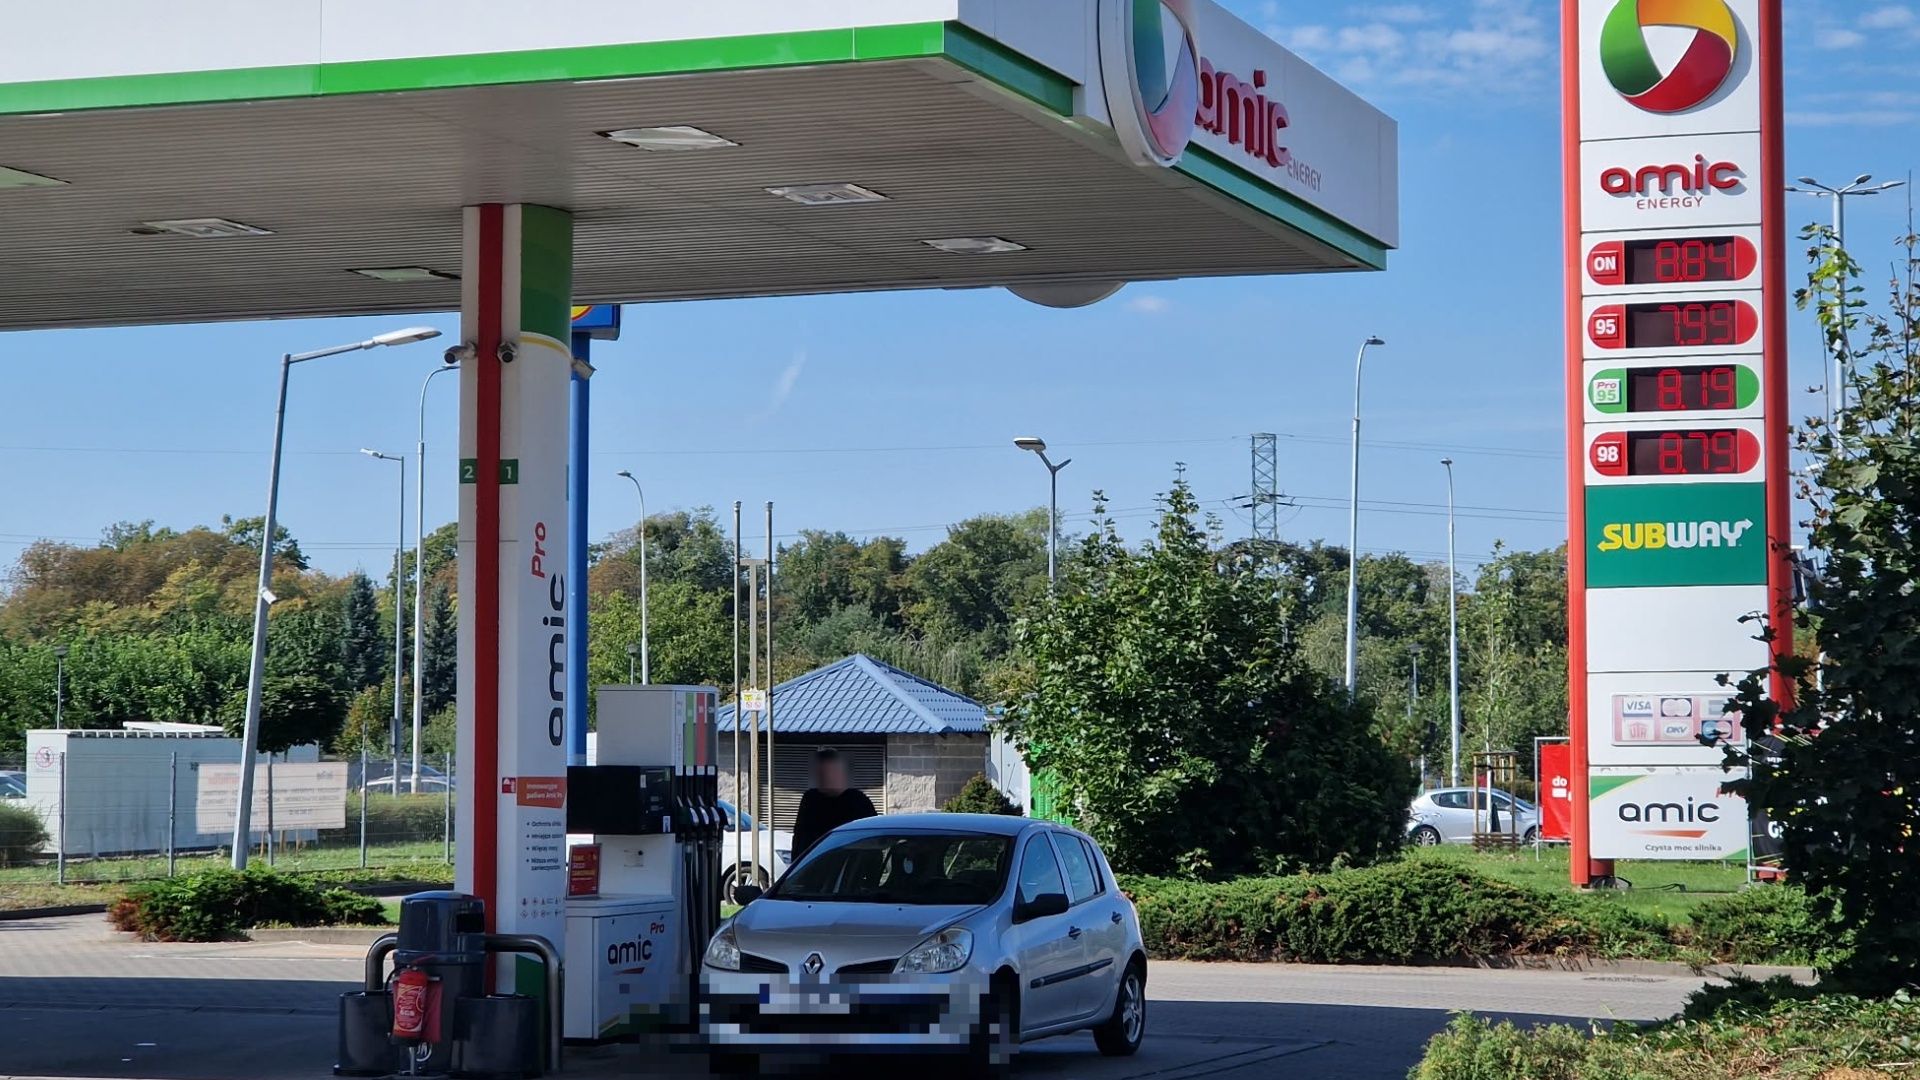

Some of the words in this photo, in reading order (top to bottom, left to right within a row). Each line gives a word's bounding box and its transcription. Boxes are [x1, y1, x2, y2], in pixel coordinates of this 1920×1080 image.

[1195, 56, 1291, 168] amic
[1287, 158, 1323, 192] ENERGY
[1600, 154, 1740, 195] amic
[1636, 196, 1704, 210] ENERGY
[1594, 256, 1617, 271] ON
[1655, 240, 1733, 282] 8.84
[1595, 318, 1617, 335] 95
[1659, 303, 1733, 345] 7.99
[1596, 381, 1617, 389] Pro
[1596, 389, 1617, 402] 95
[1657, 368, 1734, 410] 8.19
[1597, 446, 1619, 462] 98
[1658, 432, 1735, 474] 8.79
[464, 465, 474, 479] 2
[505, 465, 513, 479] 1
[531, 521, 546, 579] Pro
[1597, 518, 1754, 552] SUBWAY
[543, 573, 565, 746] amic
[1626, 700, 1652, 711] VISA
[1666, 726, 1688, 734] DKV
[1618, 796, 1720, 823] amic
[1645, 844, 1672, 853] Czysta
[1694, 844, 1723, 852] silnika
[650, 922, 665, 935] Pro
[607, 934, 653, 965] amic
